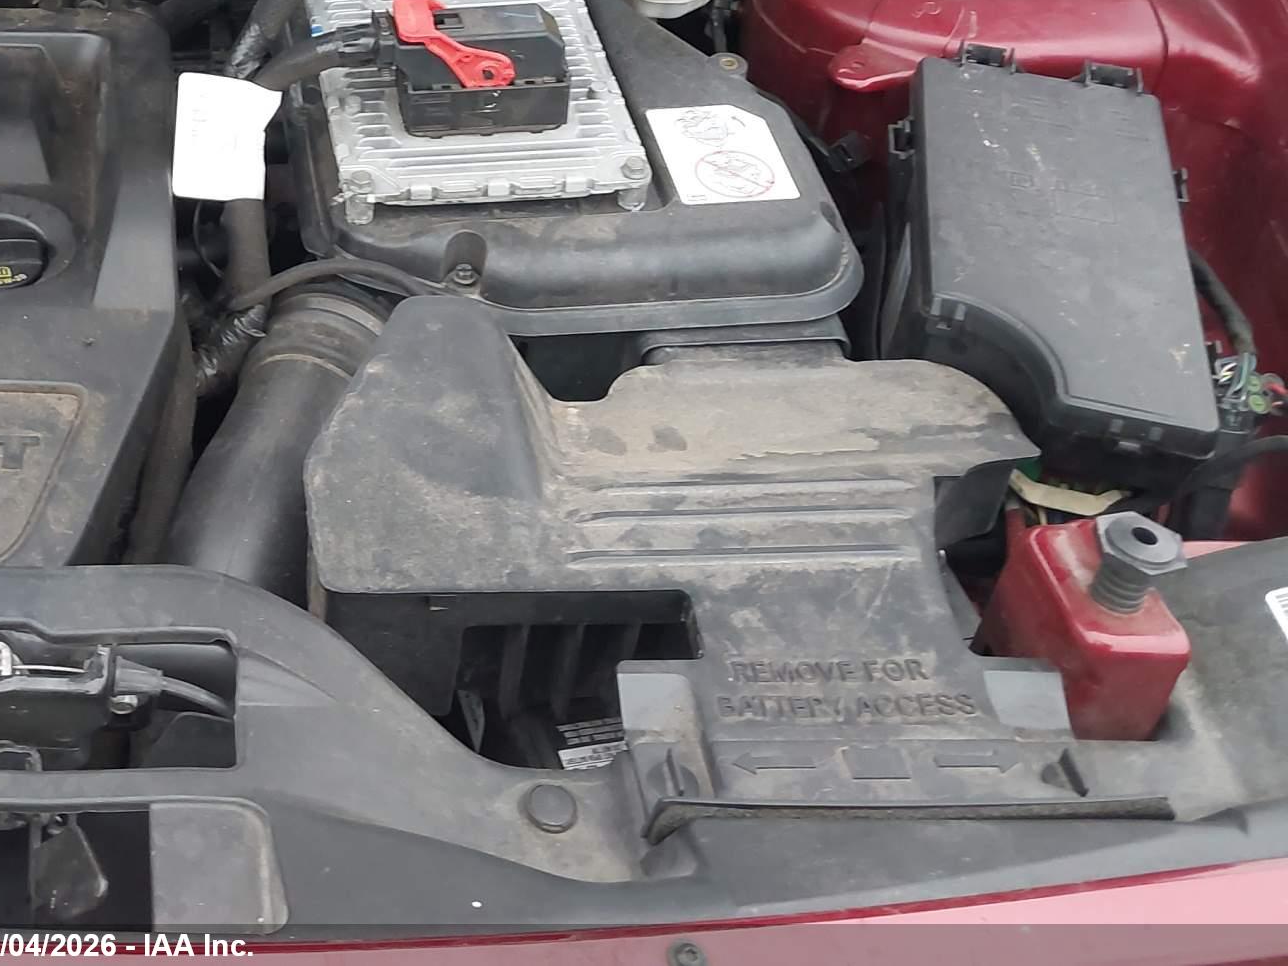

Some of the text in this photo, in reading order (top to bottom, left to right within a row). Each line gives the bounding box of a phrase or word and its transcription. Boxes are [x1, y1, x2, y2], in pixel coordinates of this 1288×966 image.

[729, 658, 929, 683] REMOVE FOR
[716, 692, 977, 718] BATTERY ACCESS
